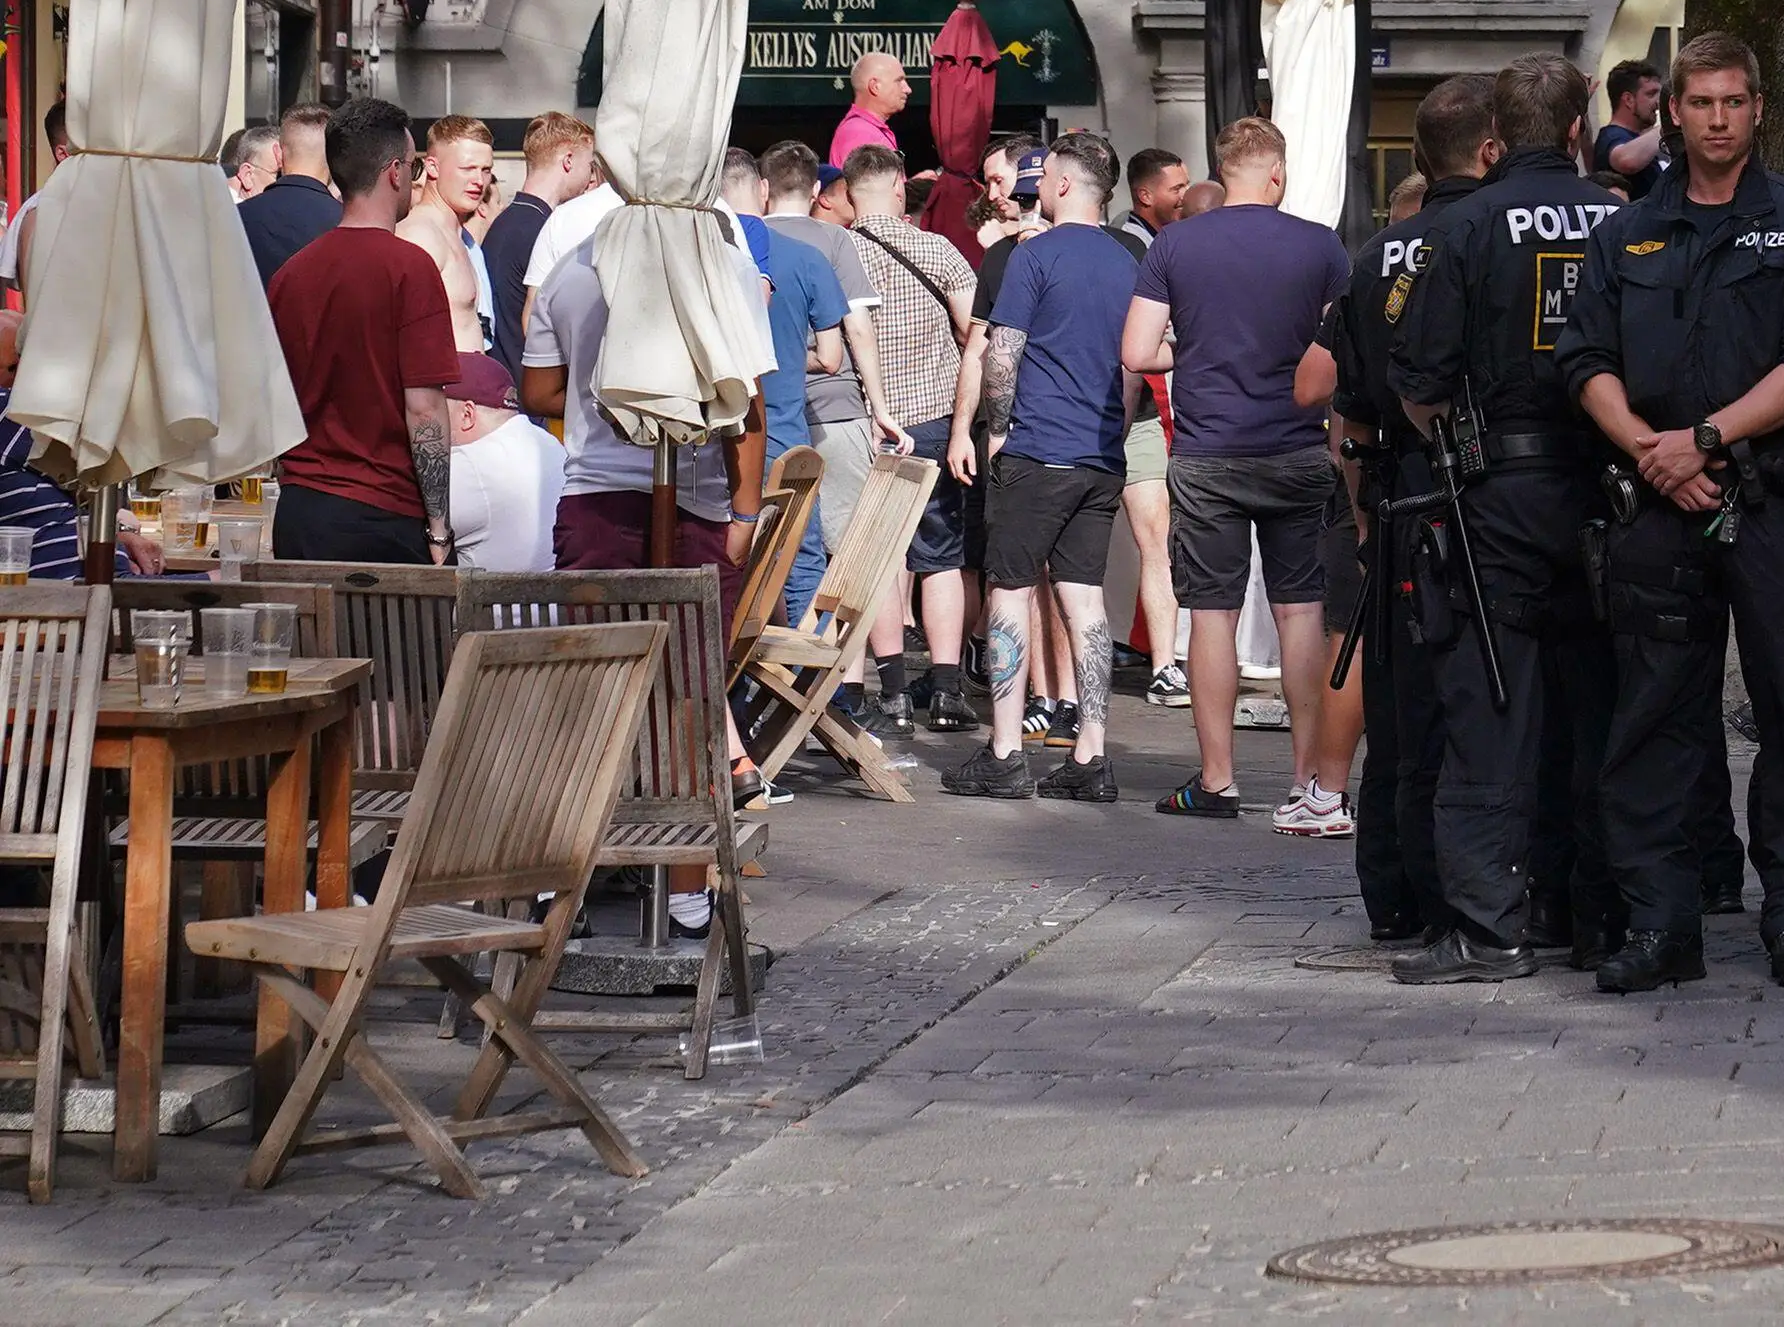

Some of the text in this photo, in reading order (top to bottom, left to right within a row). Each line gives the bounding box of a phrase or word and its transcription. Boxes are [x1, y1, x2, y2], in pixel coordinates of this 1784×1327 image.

[749, 32, 936, 68] KELLYS AUSTRALIAN
[1506, 204, 1621, 245] POLIZ
